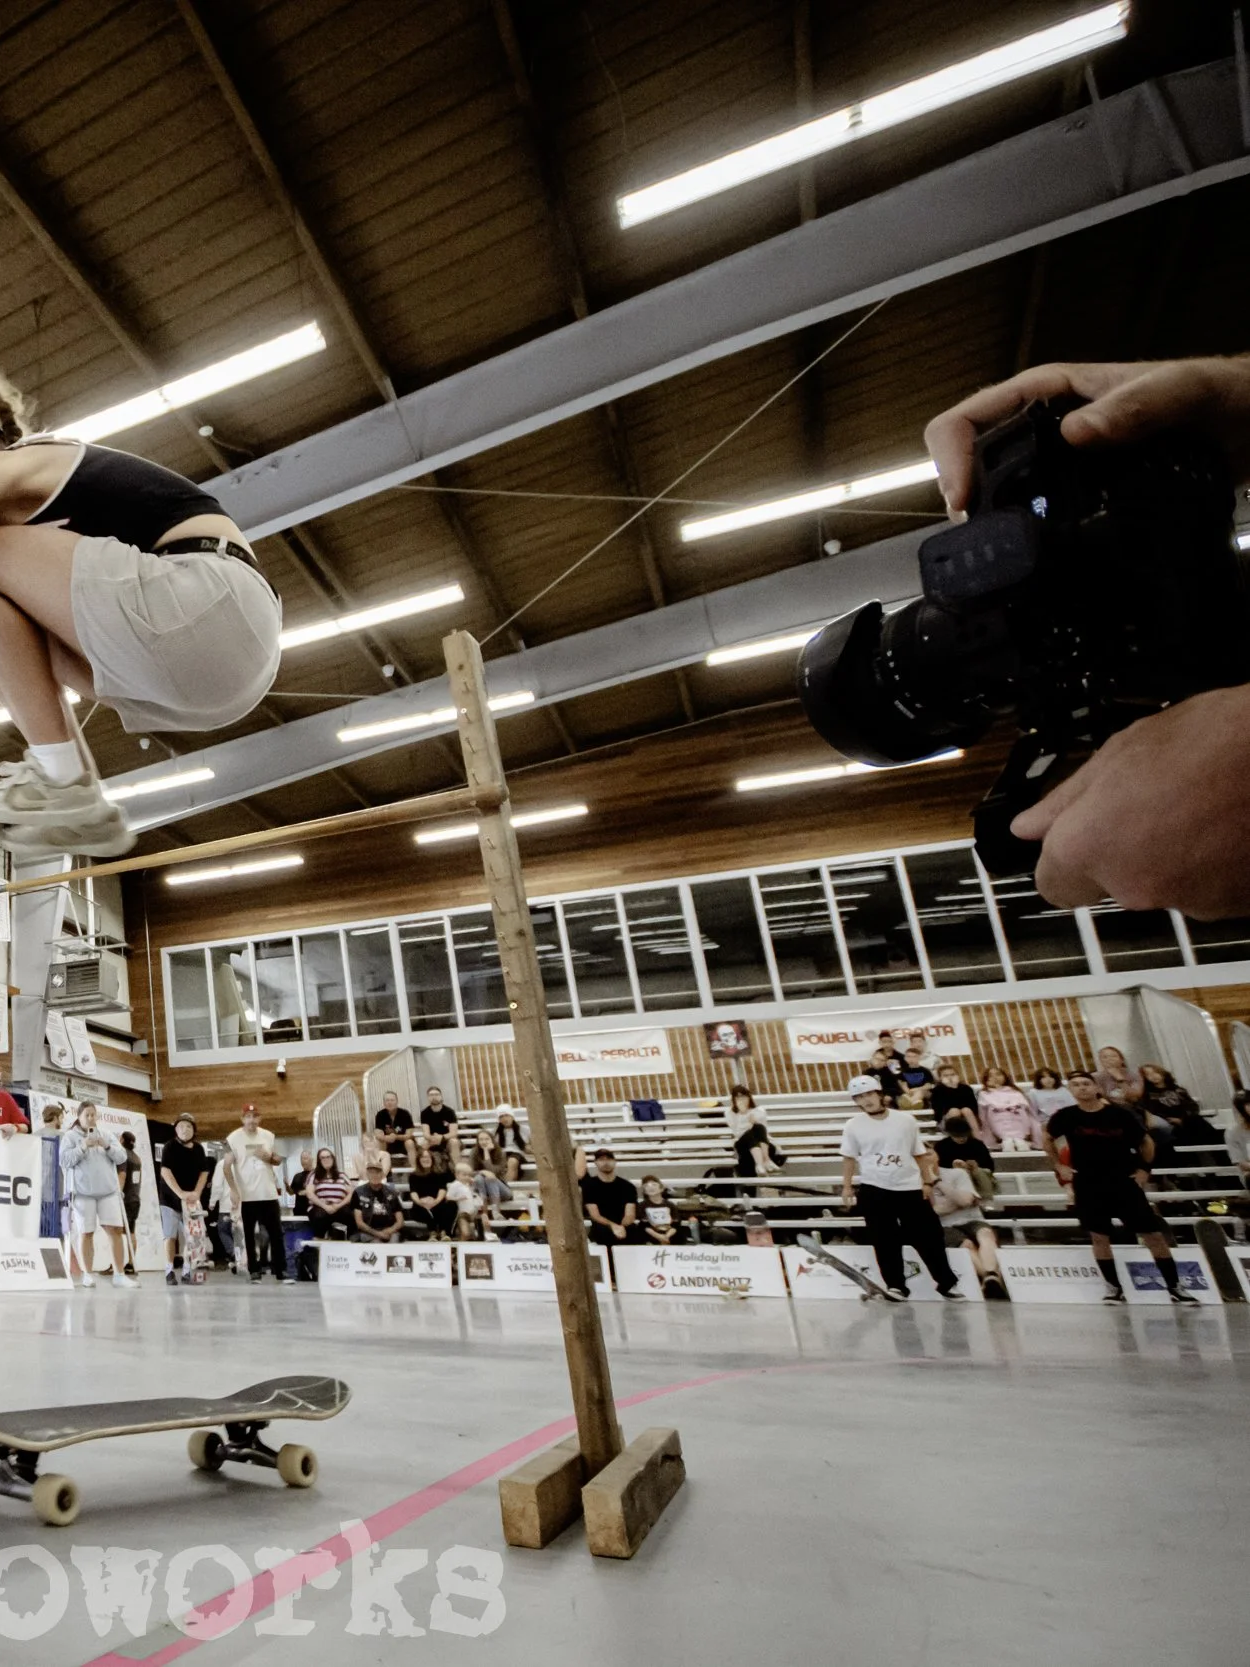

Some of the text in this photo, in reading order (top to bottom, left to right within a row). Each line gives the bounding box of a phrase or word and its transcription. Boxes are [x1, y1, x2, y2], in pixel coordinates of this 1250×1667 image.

[797, 1024, 957, 1046] POWELL ERALTA
[600, 1045, 661, 1061] PERALTA
[675, 1252, 741, 1264] Holiday Inn
[506, 1262, 554, 1273] TASHM
[1007, 1265, 1100, 1279] QUARTERHOR
